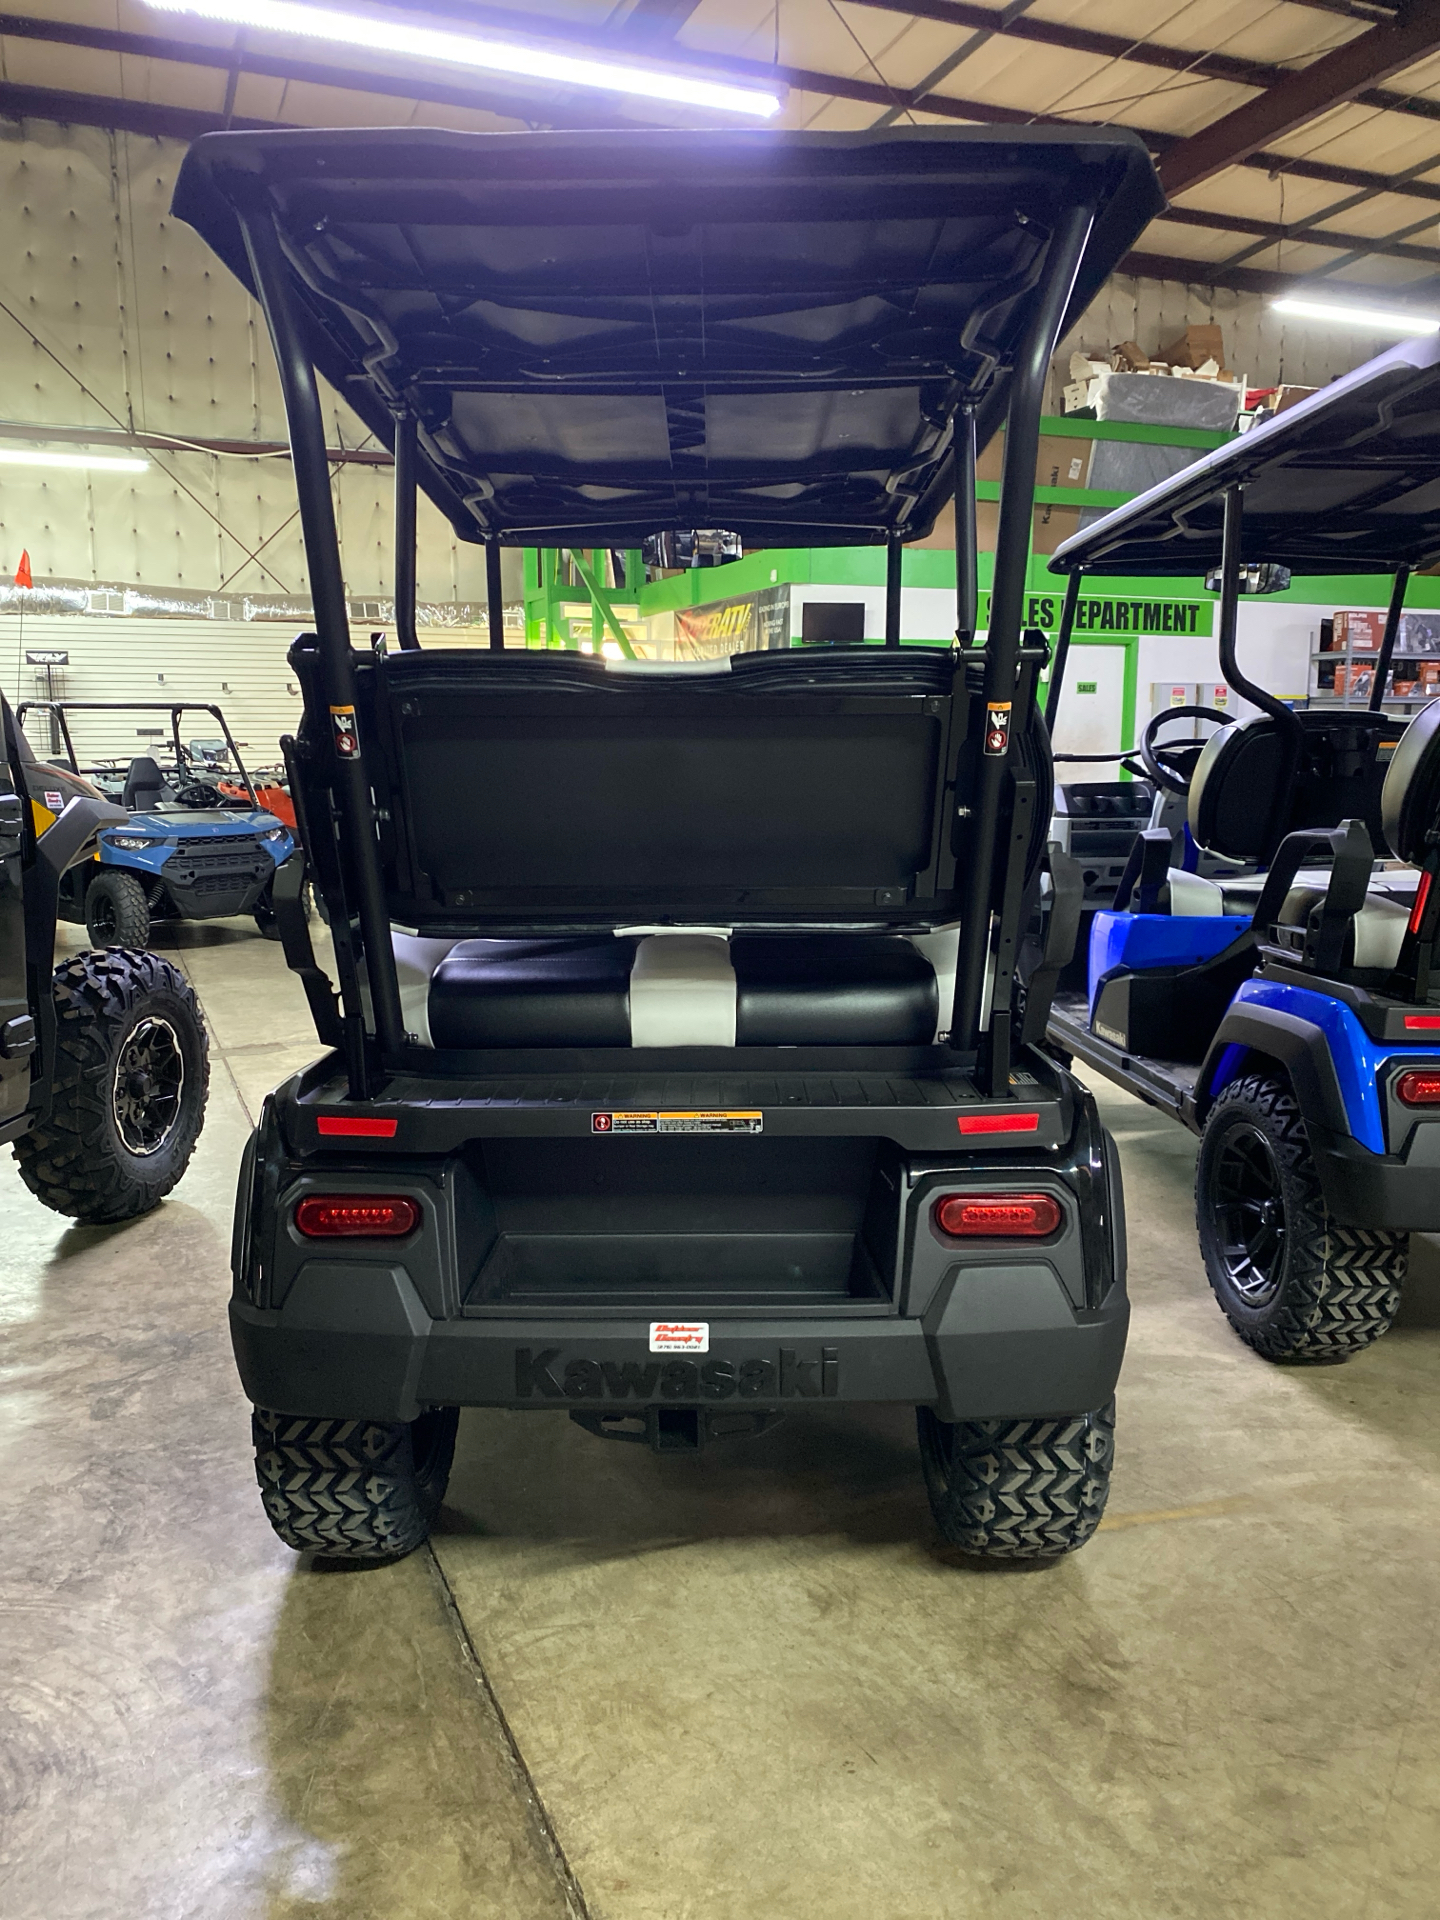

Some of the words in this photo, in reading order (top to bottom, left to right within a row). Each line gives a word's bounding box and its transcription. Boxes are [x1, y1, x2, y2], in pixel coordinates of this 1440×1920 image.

[1042, 466, 1059, 524] Kaaki
[1078, 684, 1097, 692] SALES
[1096, 1020, 1126, 1047] Kawasaki
[515, 1346, 838, 1399] Kawasaki
